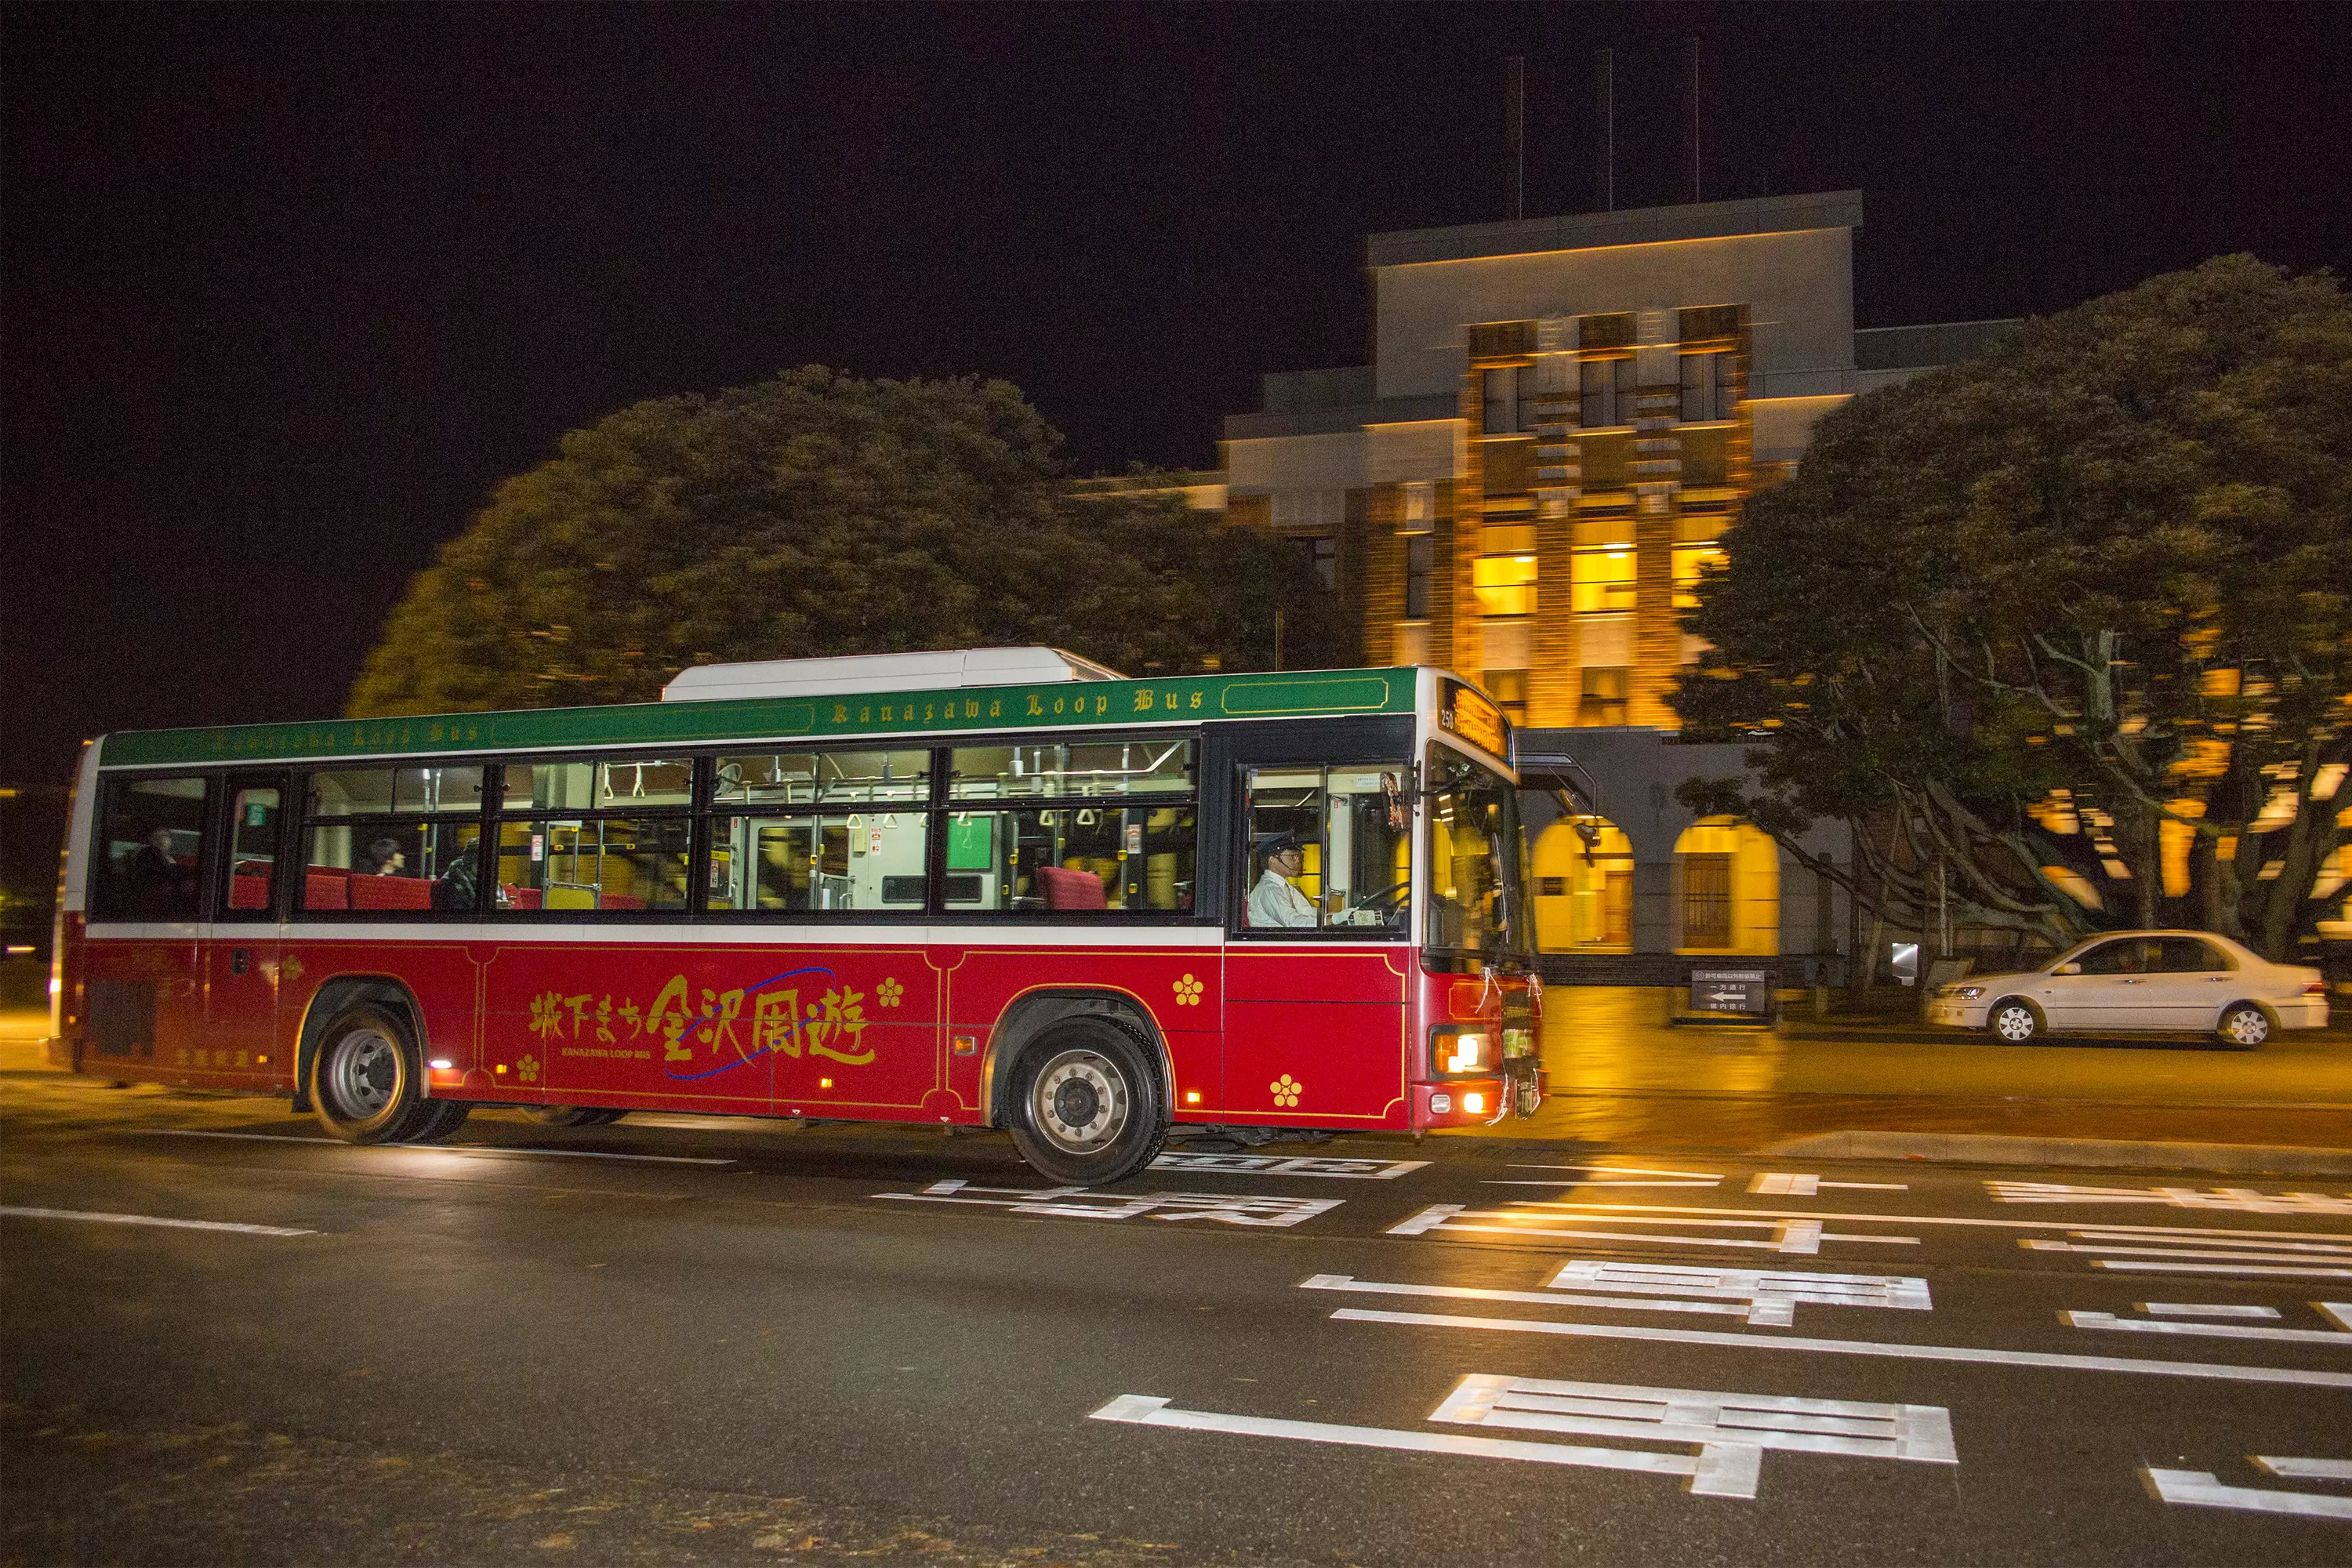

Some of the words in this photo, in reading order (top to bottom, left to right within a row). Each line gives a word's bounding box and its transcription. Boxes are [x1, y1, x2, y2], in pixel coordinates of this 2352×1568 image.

[831, 698, 1002, 724] Kanazawa
[1026, 693, 1108, 715] Loop
[1134, 688, 1203, 711] Bus
[1441, 709, 1454, 729] 250
[610, 1049, 633, 1058] LOOP
[634, 1051, 651, 1060] BUS
